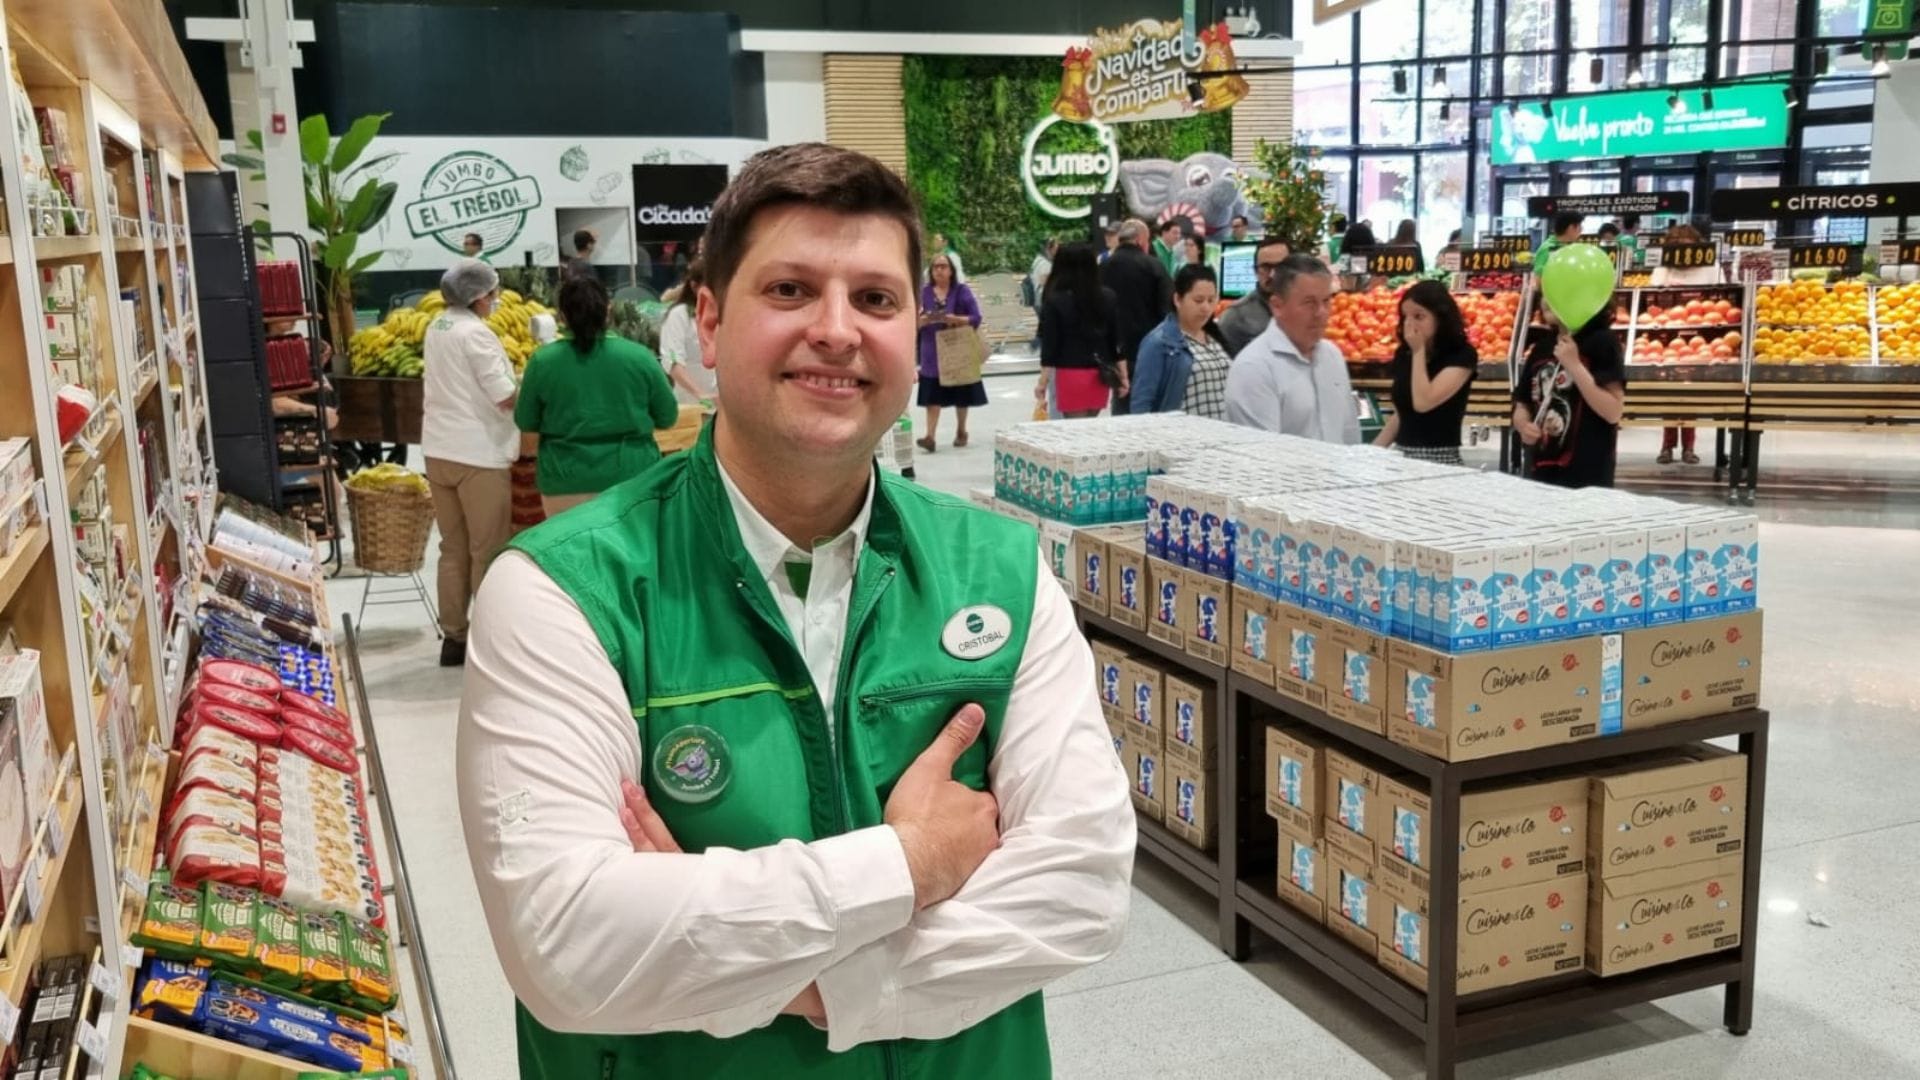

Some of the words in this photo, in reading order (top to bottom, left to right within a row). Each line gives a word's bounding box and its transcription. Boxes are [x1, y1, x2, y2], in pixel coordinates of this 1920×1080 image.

[1085, 28, 1206, 96] Navidad
[1130, 69, 1150, 87] es
[1603, 112, 1654, 155] pronto
[438, 162, 496, 193] JUMBO
[1032, 153, 1111, 176] JUMBO
[419, 205, 448, 228] EL
[450, 187, 529, 220] TRÉBOL
[1787, 194, 1879, 211] CÍTRICOS
[958, 631, 1005, 652] CRISTOBAL
